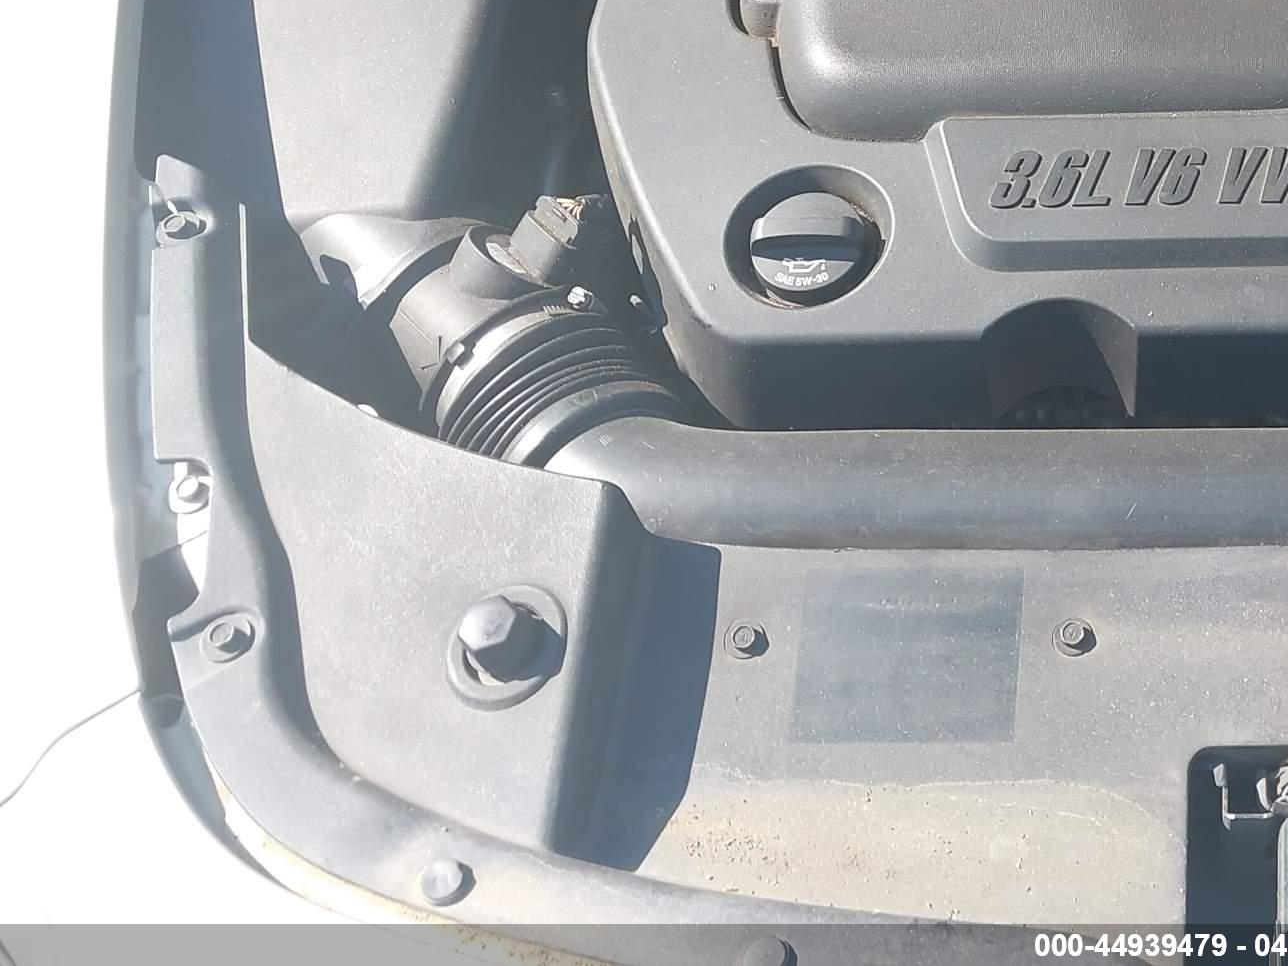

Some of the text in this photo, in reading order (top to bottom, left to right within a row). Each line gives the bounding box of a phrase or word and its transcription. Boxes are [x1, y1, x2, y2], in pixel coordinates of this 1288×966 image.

[988, 148, 1111, 210] 3.6L
[1125, 146, 1206, 206] V6
[774, 272, 829, 286] SAE 5W-30
